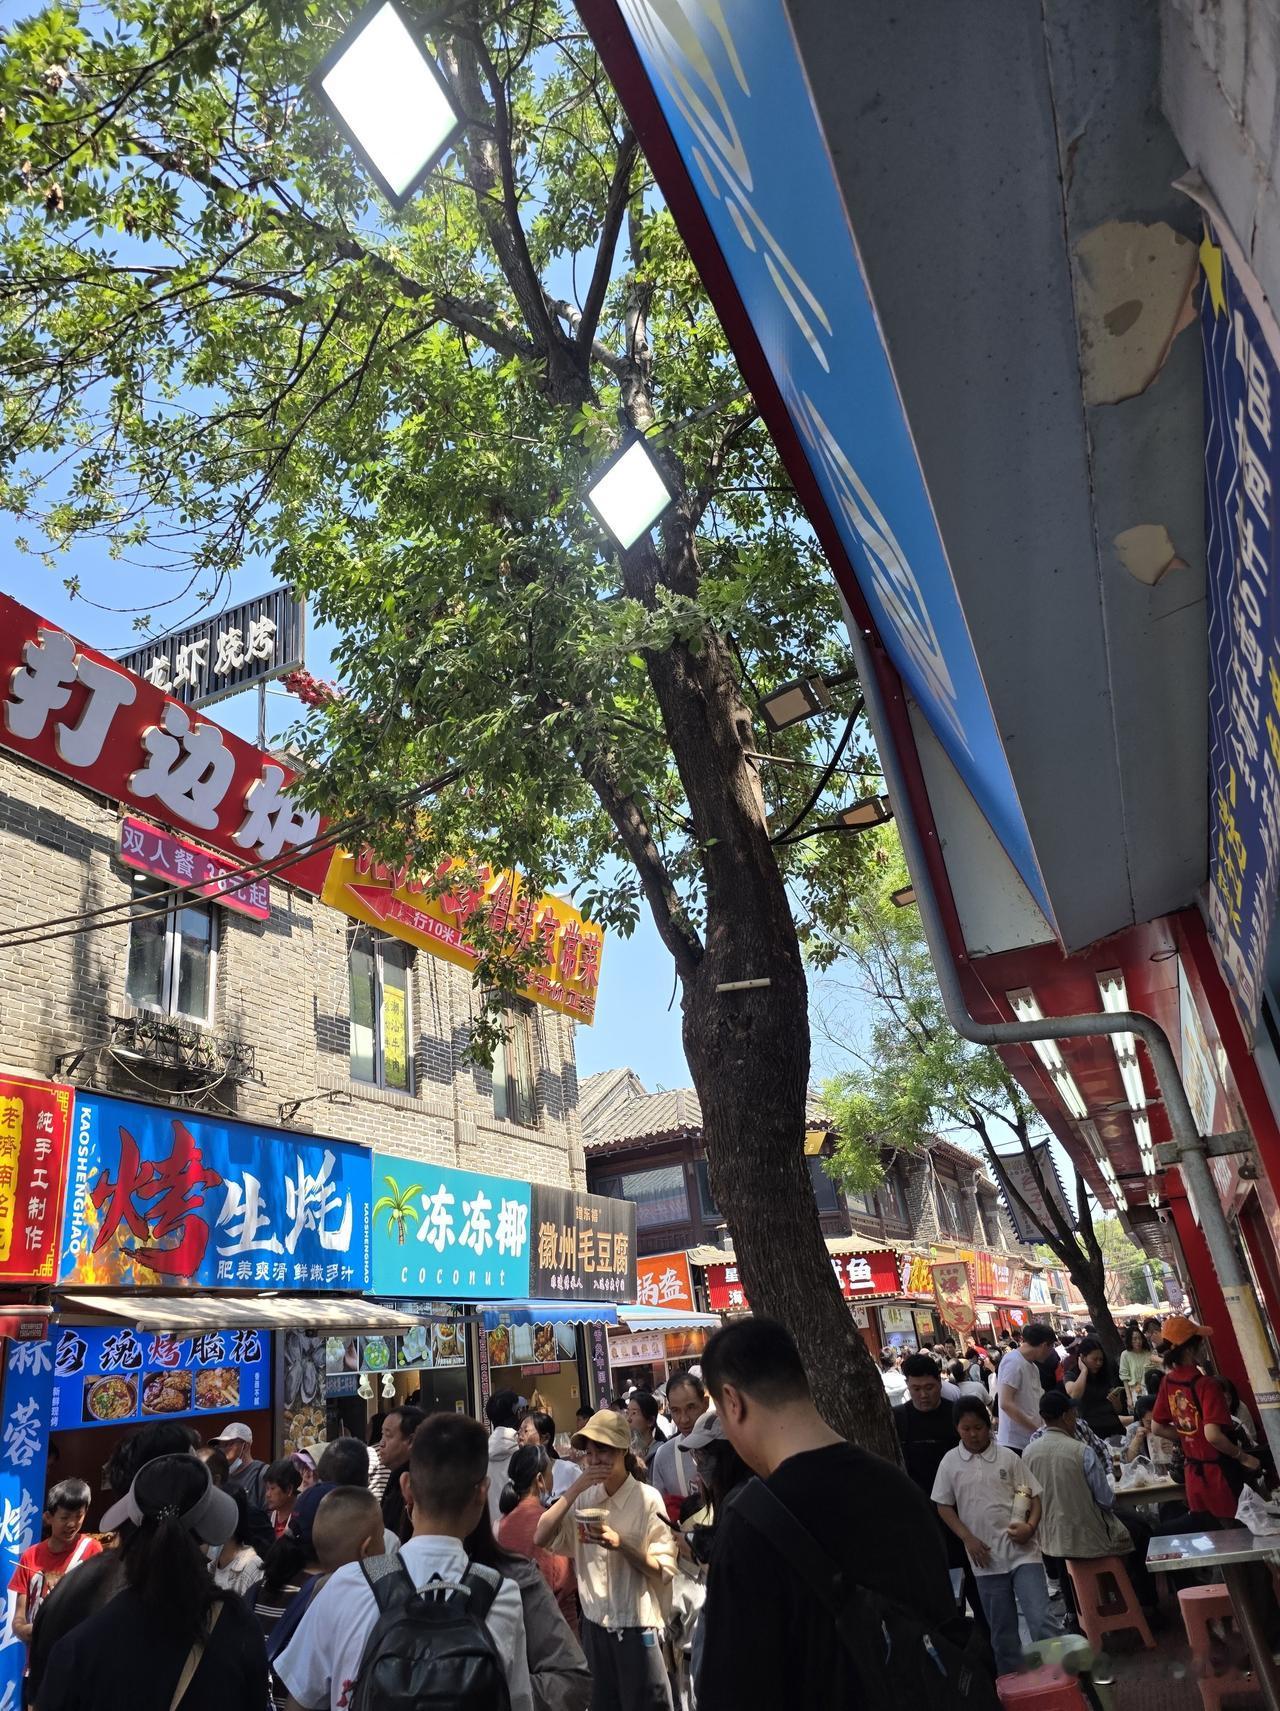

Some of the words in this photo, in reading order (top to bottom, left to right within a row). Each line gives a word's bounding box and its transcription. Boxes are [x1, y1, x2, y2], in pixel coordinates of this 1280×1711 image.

[127, 614, 277, 695] 龙虾烧烤
[4, 627, 321, 861] 打边炉
[123, 825, 194, 879] 双人餐
[69, 1106, 92, 1255] KAOSHENGHAO
[416, 1183, 528, 1258] 冻冻椰
[538, 1220, 630, 1275] 徽州毛豆腐
[216, 1259, 288, 1282] 肥美爽滑
[292, 1262, 355, 1284] 鲜嫩多汁
[401, 1266, 506, 1287] coconut
[54, 1329, 262, 1377] 勾魂烤脑花
